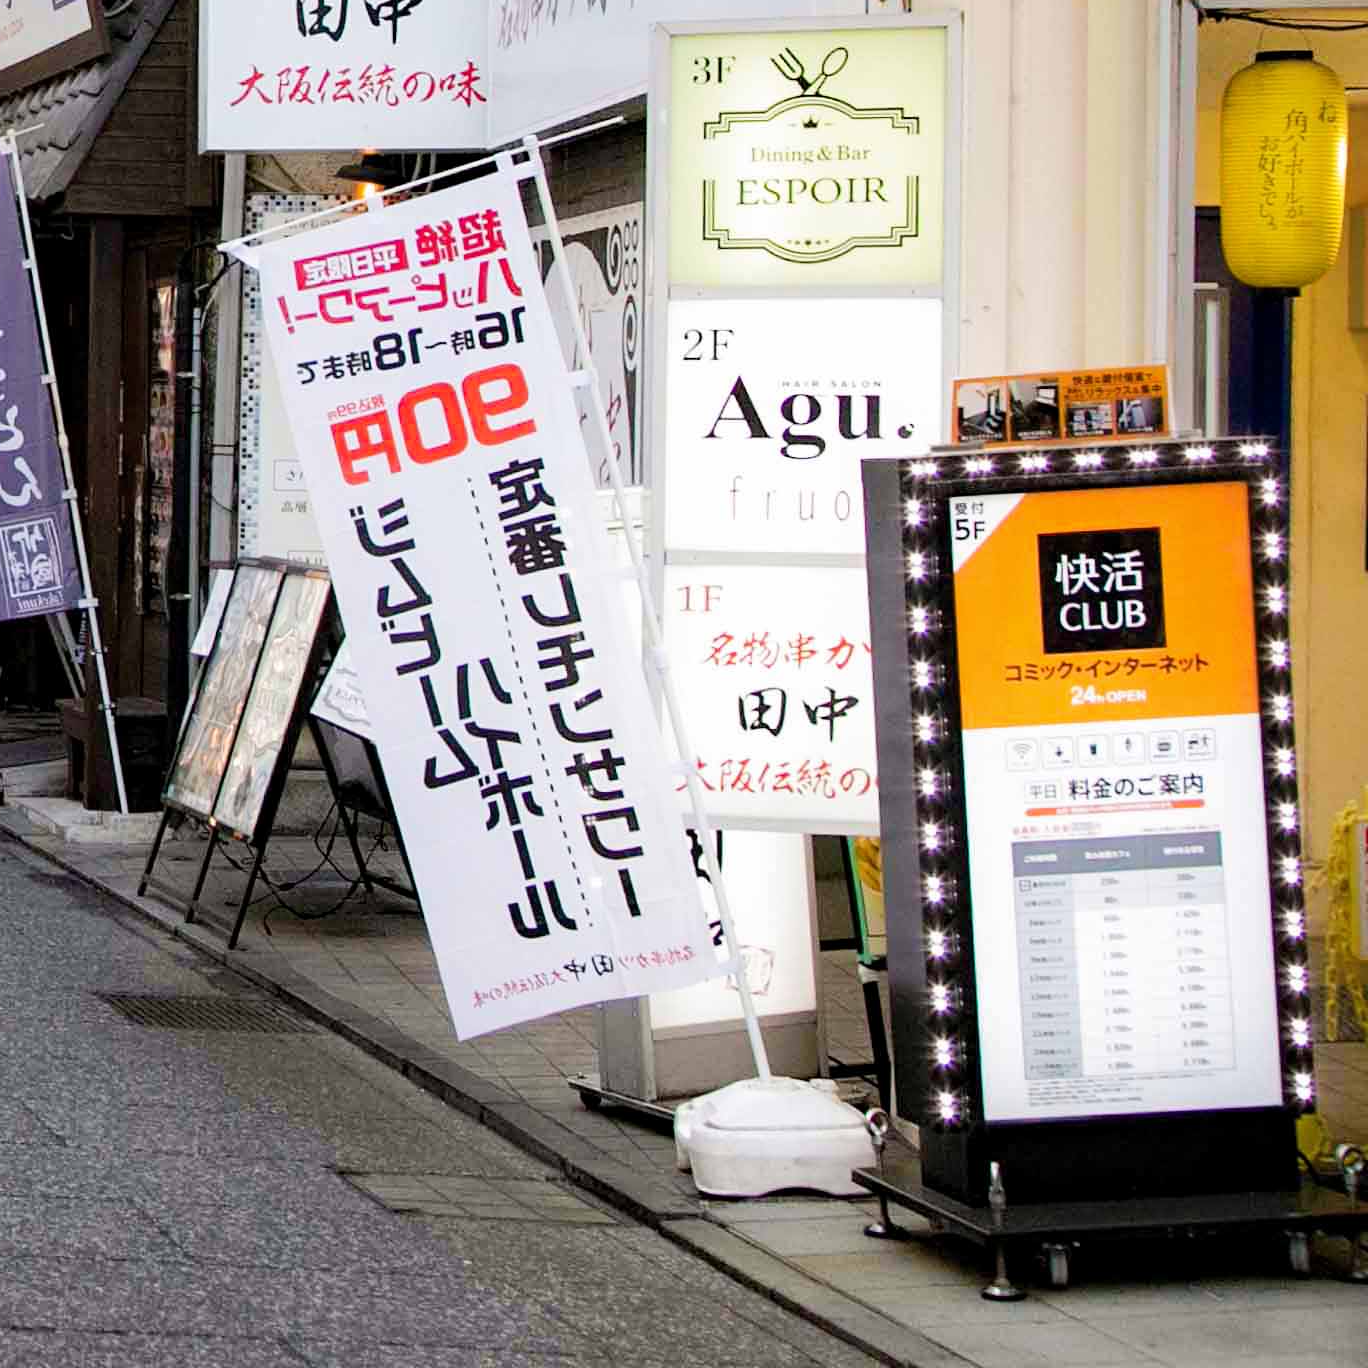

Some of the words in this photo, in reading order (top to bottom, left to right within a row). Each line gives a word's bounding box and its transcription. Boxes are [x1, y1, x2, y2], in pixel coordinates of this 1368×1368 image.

[230, 60, 487, 109] 大阪伝統の味
[693, 56, 736, 85] 3F
[750, 144, 814, 166] Dining
[837, 144, 871, 163] Bar
[737, 175, 889, 208] ESPOIR
[683, 329, 734, 361] 2F
[782, 379, 828, 388] HAIR
[838, 378, 884, 388] SALON
[708, 374, 915, 459] Agu.
[730, 474, 852, 522] fruo
[955, 501, 985, 517] 受付
[954, 519, 985, 542] 5F
[1055, 550, 1145, 596] 快活
[678, 584, 723, 613] 1F
[1059, 600, 1147, 633] CLUB
[1106, 687, 1147, 703] OPEN
[737, 687, 861, 744] 田中
[674, 756, 878, 797] 大阪伝統の
[1030, 784, 1058, 800] 平日
[1068, 772, 1205, 801] 料金のご案内
